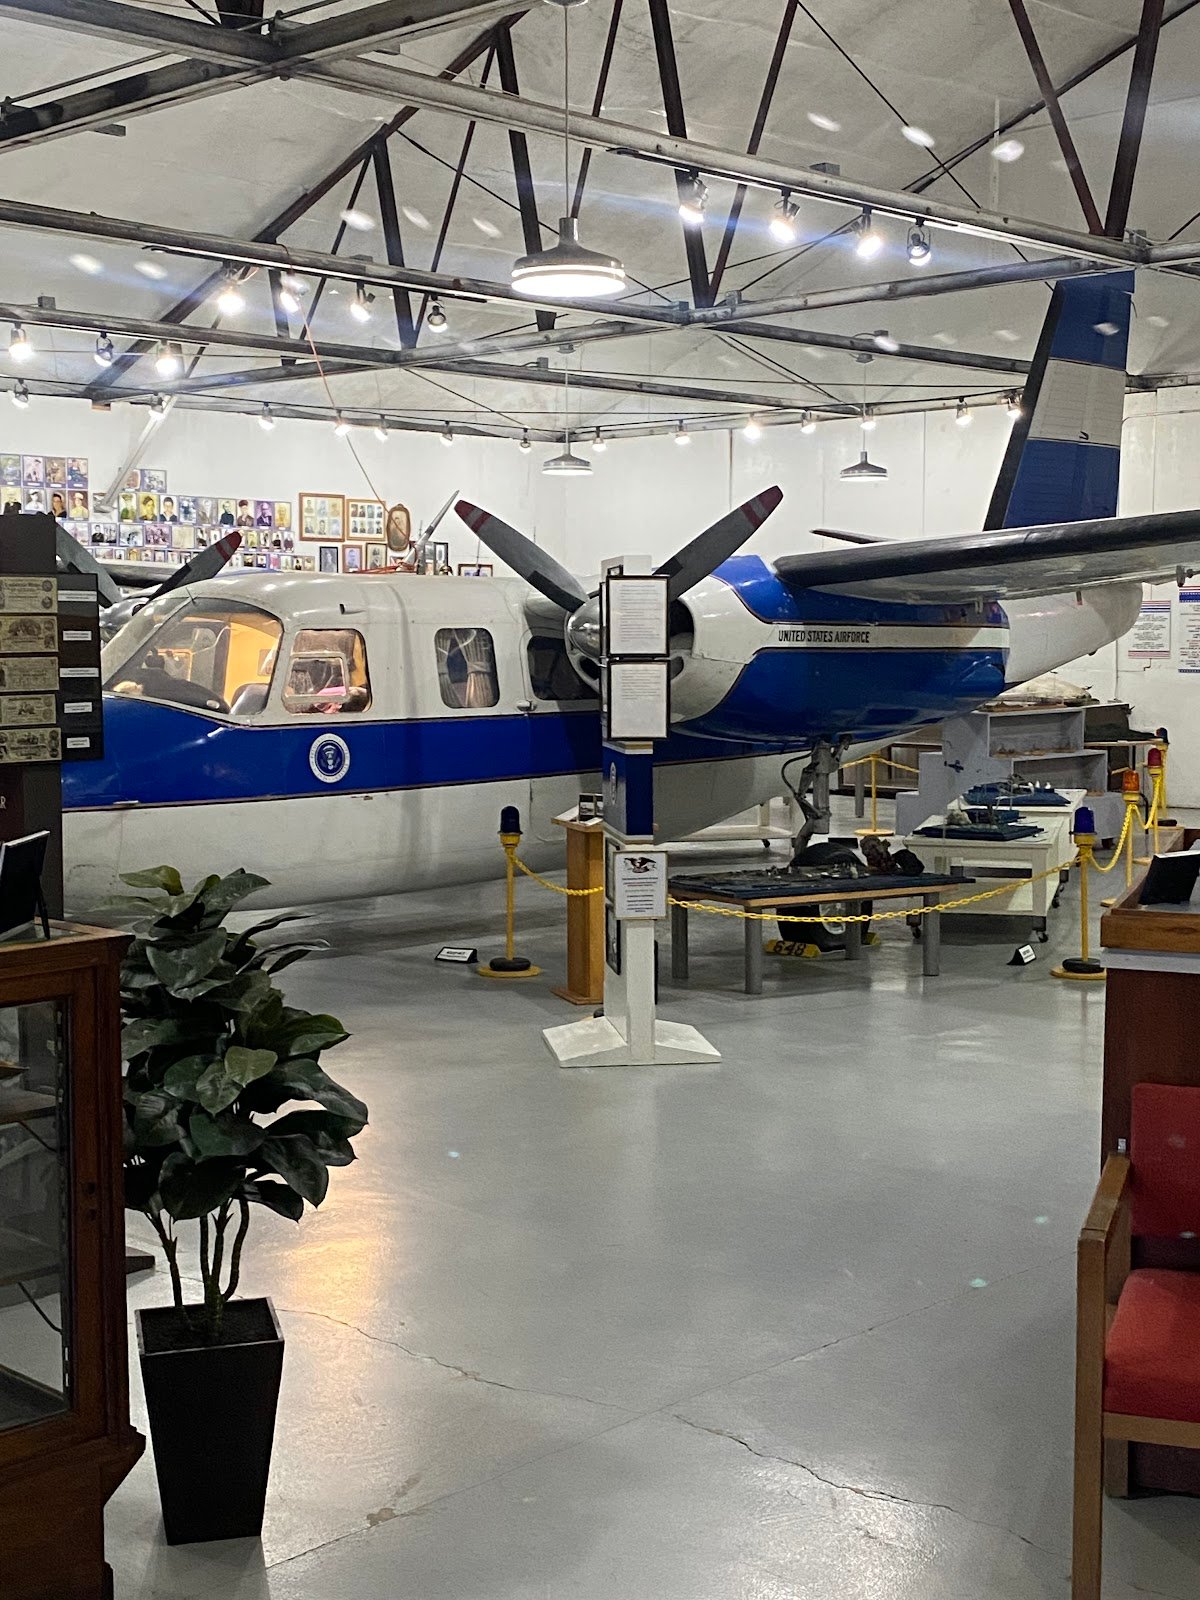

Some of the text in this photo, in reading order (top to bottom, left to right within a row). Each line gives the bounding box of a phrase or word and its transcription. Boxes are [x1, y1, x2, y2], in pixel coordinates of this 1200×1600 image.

[778, 630, 870, 643] UNITED STATES AIRFORCE
[773, 940, 807, 956] 648
